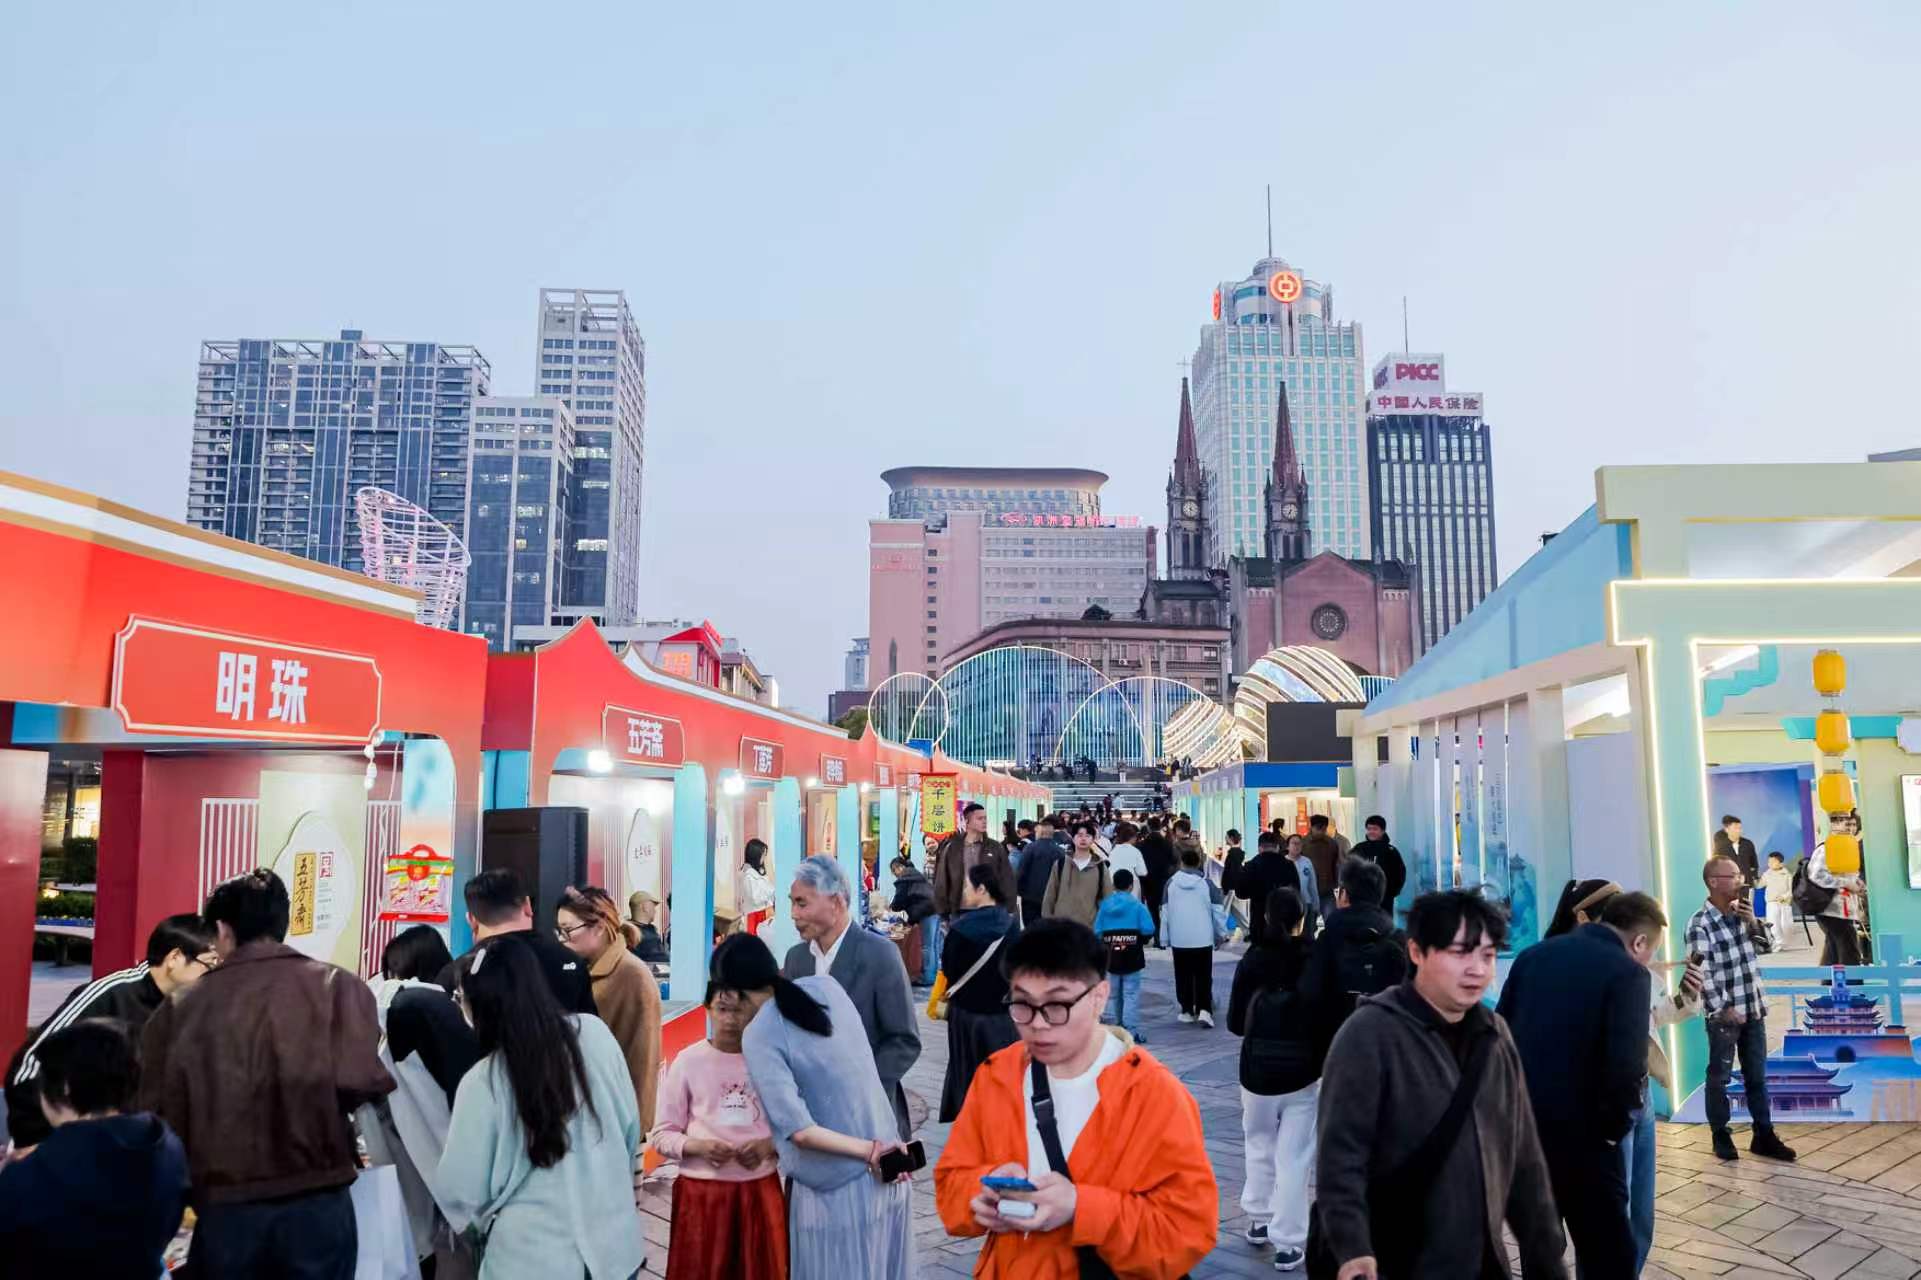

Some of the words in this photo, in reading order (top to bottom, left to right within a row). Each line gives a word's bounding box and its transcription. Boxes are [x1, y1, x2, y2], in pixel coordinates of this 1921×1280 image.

[1396, 363, 1439, 380] PICC
[1377, 396, 1479, 410] 中国人民保险
[215, 652, 308, 724] 明珠
[627, 717, 664, 759] 五芳斋
